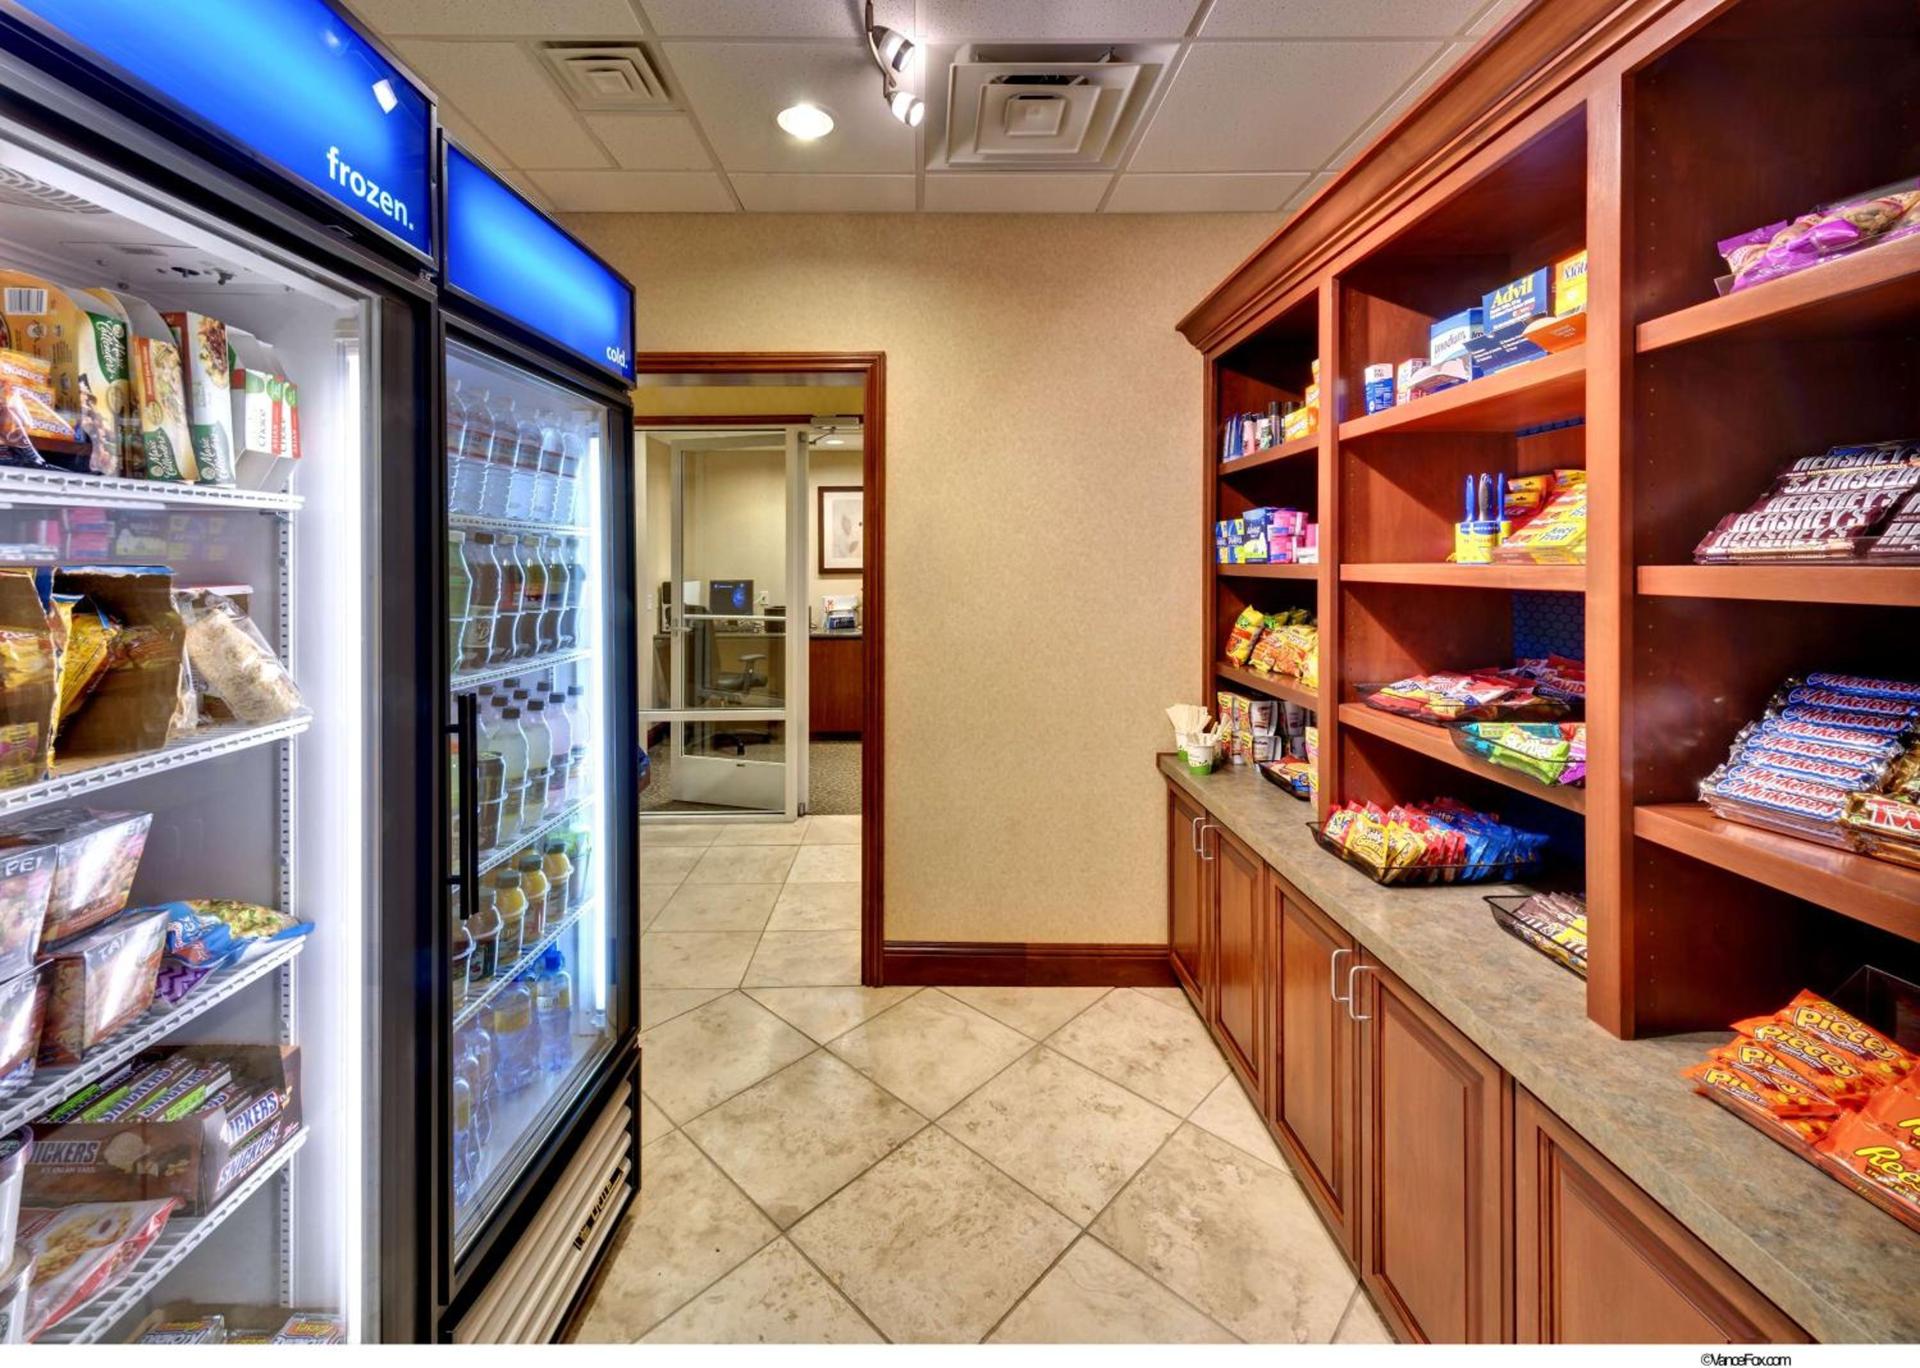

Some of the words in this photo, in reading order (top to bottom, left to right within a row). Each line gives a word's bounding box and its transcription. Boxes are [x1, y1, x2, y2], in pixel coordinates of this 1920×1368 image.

[326, 145, 414, 231] frozen.
[1490, 273, 1536, 310] Advil
[606, 346, 629, 369] cold.
[1792, 445, 1905, 472] HERSHEY
[1732, 507, 1868, 534] HERSHEY'S
[1754, 1024, 1862, 1079] Pieces
[1795, 1006, 1902, 1061] Pieces
